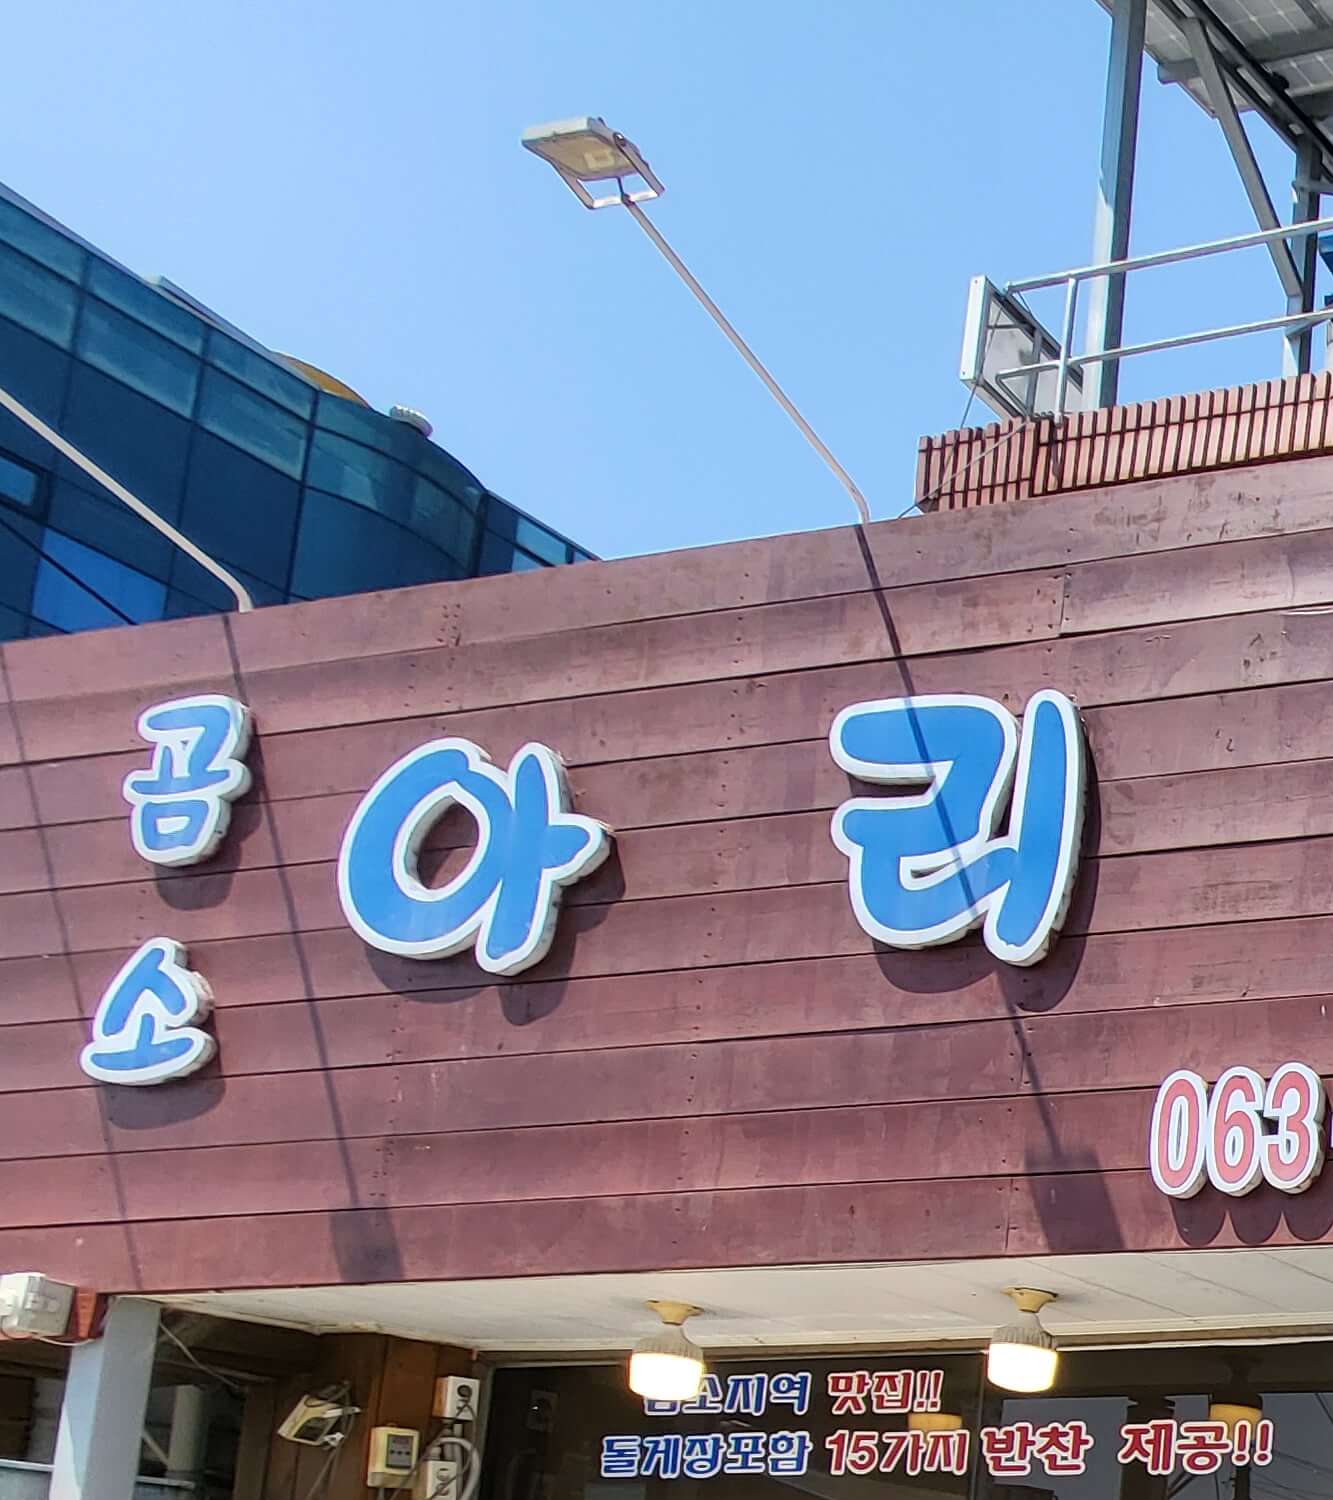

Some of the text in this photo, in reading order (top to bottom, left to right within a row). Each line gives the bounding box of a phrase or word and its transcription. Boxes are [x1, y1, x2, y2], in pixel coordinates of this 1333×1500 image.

[826, 1370, 944, 1415] 맛집!!
[601, 1419, 1274, 1479] 돌게장포함 15가지 반찬 제공!!
